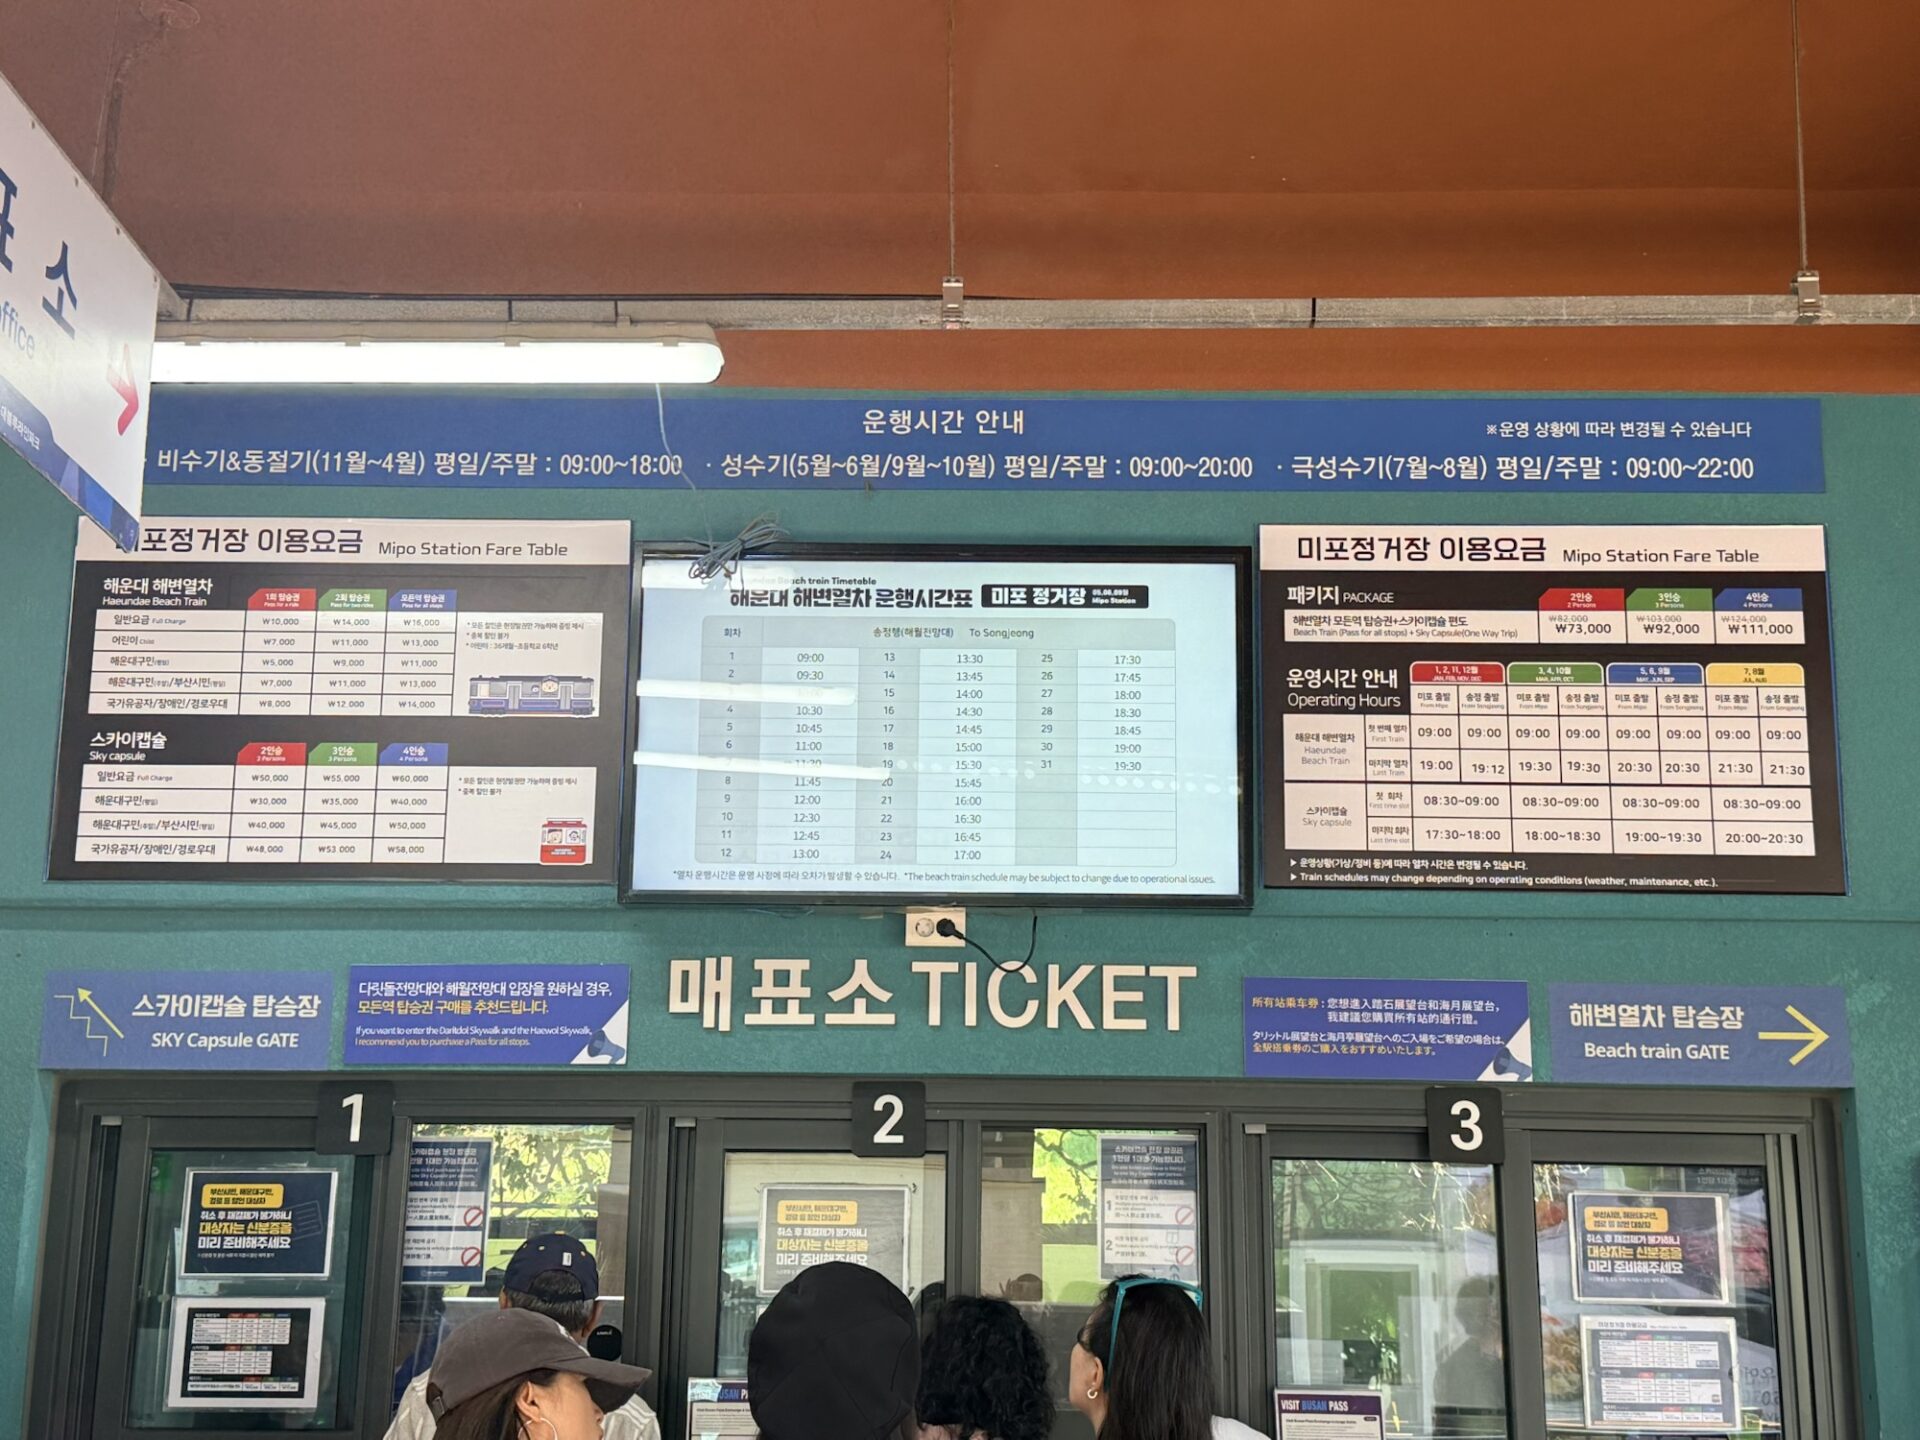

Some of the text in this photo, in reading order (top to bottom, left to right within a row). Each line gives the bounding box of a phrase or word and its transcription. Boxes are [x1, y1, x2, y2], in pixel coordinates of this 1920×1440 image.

[0, 301, 35, 360] ffice
[863, 410, 1023, 434] 운행시간 안내
[1534, 422, 1579, 438] 상황에
[1586, 422, 1615, 437] 따라
[1621, 422, 1665, 437] 변경될
[1670, 422, 1685, 437] 수
[1691, 422, 1752, 437] 있습니다
[158, 450, 681, 476] 비수기&동절기(11월~4월) 평일/주말 09:00~18:00
[721, 454, 1252, 478] 성수기(5월~6월/9월~10월) 평일/주말 09:00~20:00
[1292, 456, 1753, 480] 극성수기(7월~8월) 평일/주말 09:00~22:00
[115, 529, 363, 553] 포정거장 이용요금
[379, 542, 567, 556] Mipo Station Fare Table
[1298, 537, 1546, 561] 미포정거장 이용요금
[1564, 549, 1759, 565] Mipo Station Fare Table
[104, 578, 213, 595] 해운대 해변열차
[807, 576, 877, 586] train Timetable
[102, 596, 208, 607] Haeundae Beach Train
[793, 588, 872, 607] 해변열차
[876, 588, 972, 608] 운행시간표
[992, 587, 1086, 605] 미포 정거장
[1288, 586, 1395, 605] 패키지 PACKAGE
[1571, 592, 1592, 604] 2인승
[1657, 592, 1681, 605] 3인승
[1745, 592, 1770, 605] 4인승
[1292, 615, 1469, 628] 해변열차 모든역 탑승권+스카이캡슐 편도
[968, 628, 1035, 640] To Songjeong
[1555, 623, 1612, 635] ₩73,000
[1643, 623, 1700, 635] ₩92,000
[1728, 623, 1794, 635] ₩111,000
[111, 635, 139, 646] 어린이
[796, 652, 825, 663] 09:00
[956, 654, 984, 664] 13:30
[1114, 655, 1142, 665] 17:30
[956, 671, 983, 682] 13:45
[1114, 672, 1142, 683] 17:45
[1287, 669, 1397, 688] 운영시간 안내
[1288, 693, 1401, 710] Operating Hours
[1417, 727, 1452, 738] 09:00
[1467, 727, 1502, 738] 09:00
[90, 732, 167, 749] 스카이캡슐
[955, 742, 983, 753] 15:00
[1114, 743, 1142, 754] 19:00
[89, 750, 147, 763] Sky capsule
[1419, 760, 1454, 771] 19:00
[1471, 763, 1505, 775] 19:12
[1567, 761, 1601, 774] 19:30
[1718, 763, 1754, 774] 21:30
[1423, 795, 1500, 807] 08:30~09:00
[1425, 829, 1501, 841] 17:30~18:00
[1525, 830, 1601, 842] 18:00~18:30
[1625, 832, 1702, 843] 19:00~19:30
[1725, 833, 1804, 844] 20:00~20:30
[1300, 872, 1323, 881] Train
[1323, 872, 1370, 882] schedules
[1370, 874, 1391, 884] may
[1391, 873, 1425, 885] change
[1425, 874, 1475, 886] depending
[1475, 876, 1488, 884] on
[1488, 875, 1534, 887] operating
[1534, 875, 1583, 885] conditions
[1583, 876, 1628, 887] (weather,
[1628, 877, 1693, 887] maintenance,
[359, 982, 612, 996] 다릿돌전망대와 해월전망대 입장을 원하실 경우,
[668, 957, 1197, 1031] 매표소 TICKET
[132, 995, 321, 1017] 스카이캡슐 탑승장
[358, 1000, 548, 1014] 모든역 탑승권 구매를 추천드립니다.
[1569, 1003, 1744, 1029] 해변열차 탑승장
[468, 1026, 502, 1038] Skywalk
[498, 1026, 517, 1035] and
[514, 1026, 532, 1035] the
[527, 1026, 560, 1035] Haewol
[152, 1033, 299, 1051] SKY Capsule GATE
[1585, 1043, 1729, 1059] Beach train GATE
[343, 1094, 363, 1142] 1
[874, 1095, 903, 1143] 2
[1451, 1100, 1483, 1150] 3
[199, 1222, 292, 1235] 대상자는 신분증을
[198, 1236, 291, 1249] 미리 준비해주세요
[1587, 1245, 1633, 1258] 대상자는
[1588, 1260, 1683, 1276] 미리 준비해주세요
[719, 1388, 740, 1400] USAN
[1280, 1399, 1349, 1412] VISIT BUSAN PASS
